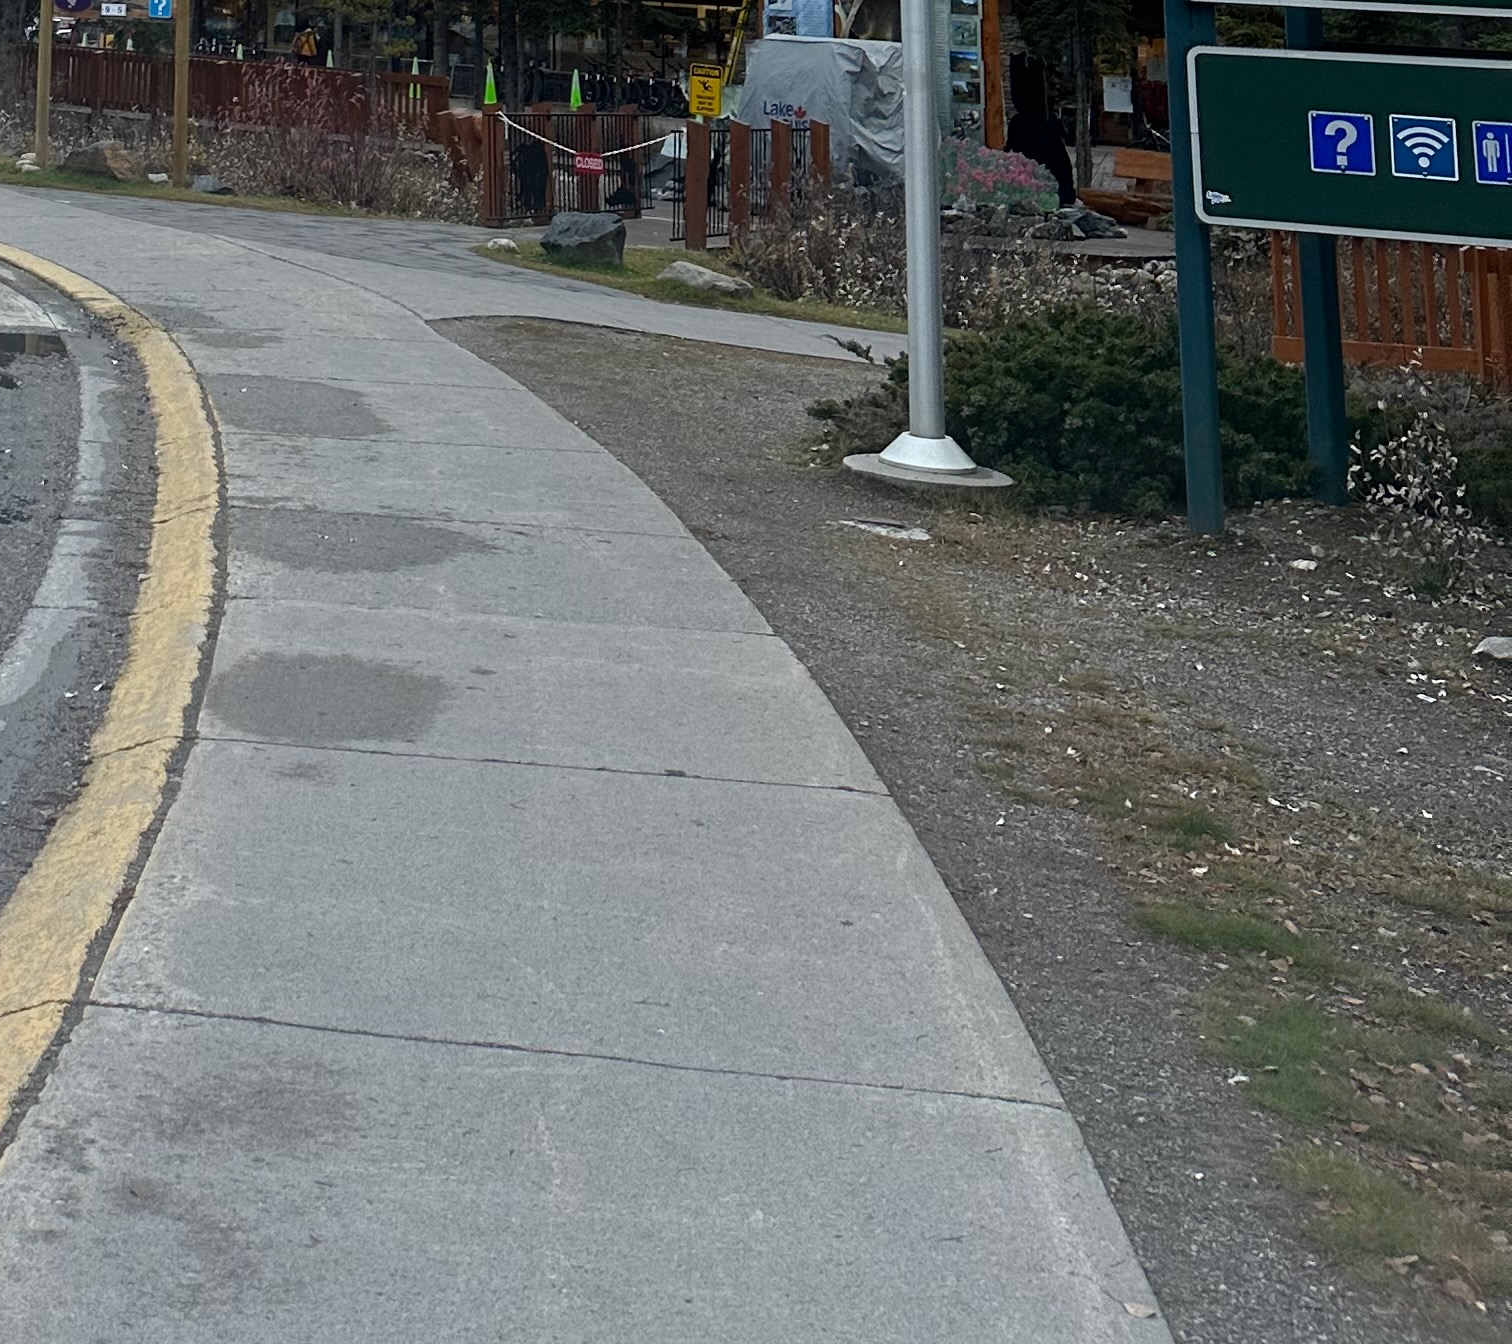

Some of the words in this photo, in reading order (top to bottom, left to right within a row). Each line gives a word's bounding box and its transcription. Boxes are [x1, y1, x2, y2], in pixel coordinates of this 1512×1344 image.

[117, 5, 123, 14] 5
[763, 101, 794, 117] Lake
[575, 156, 604, 170] CLOSED
